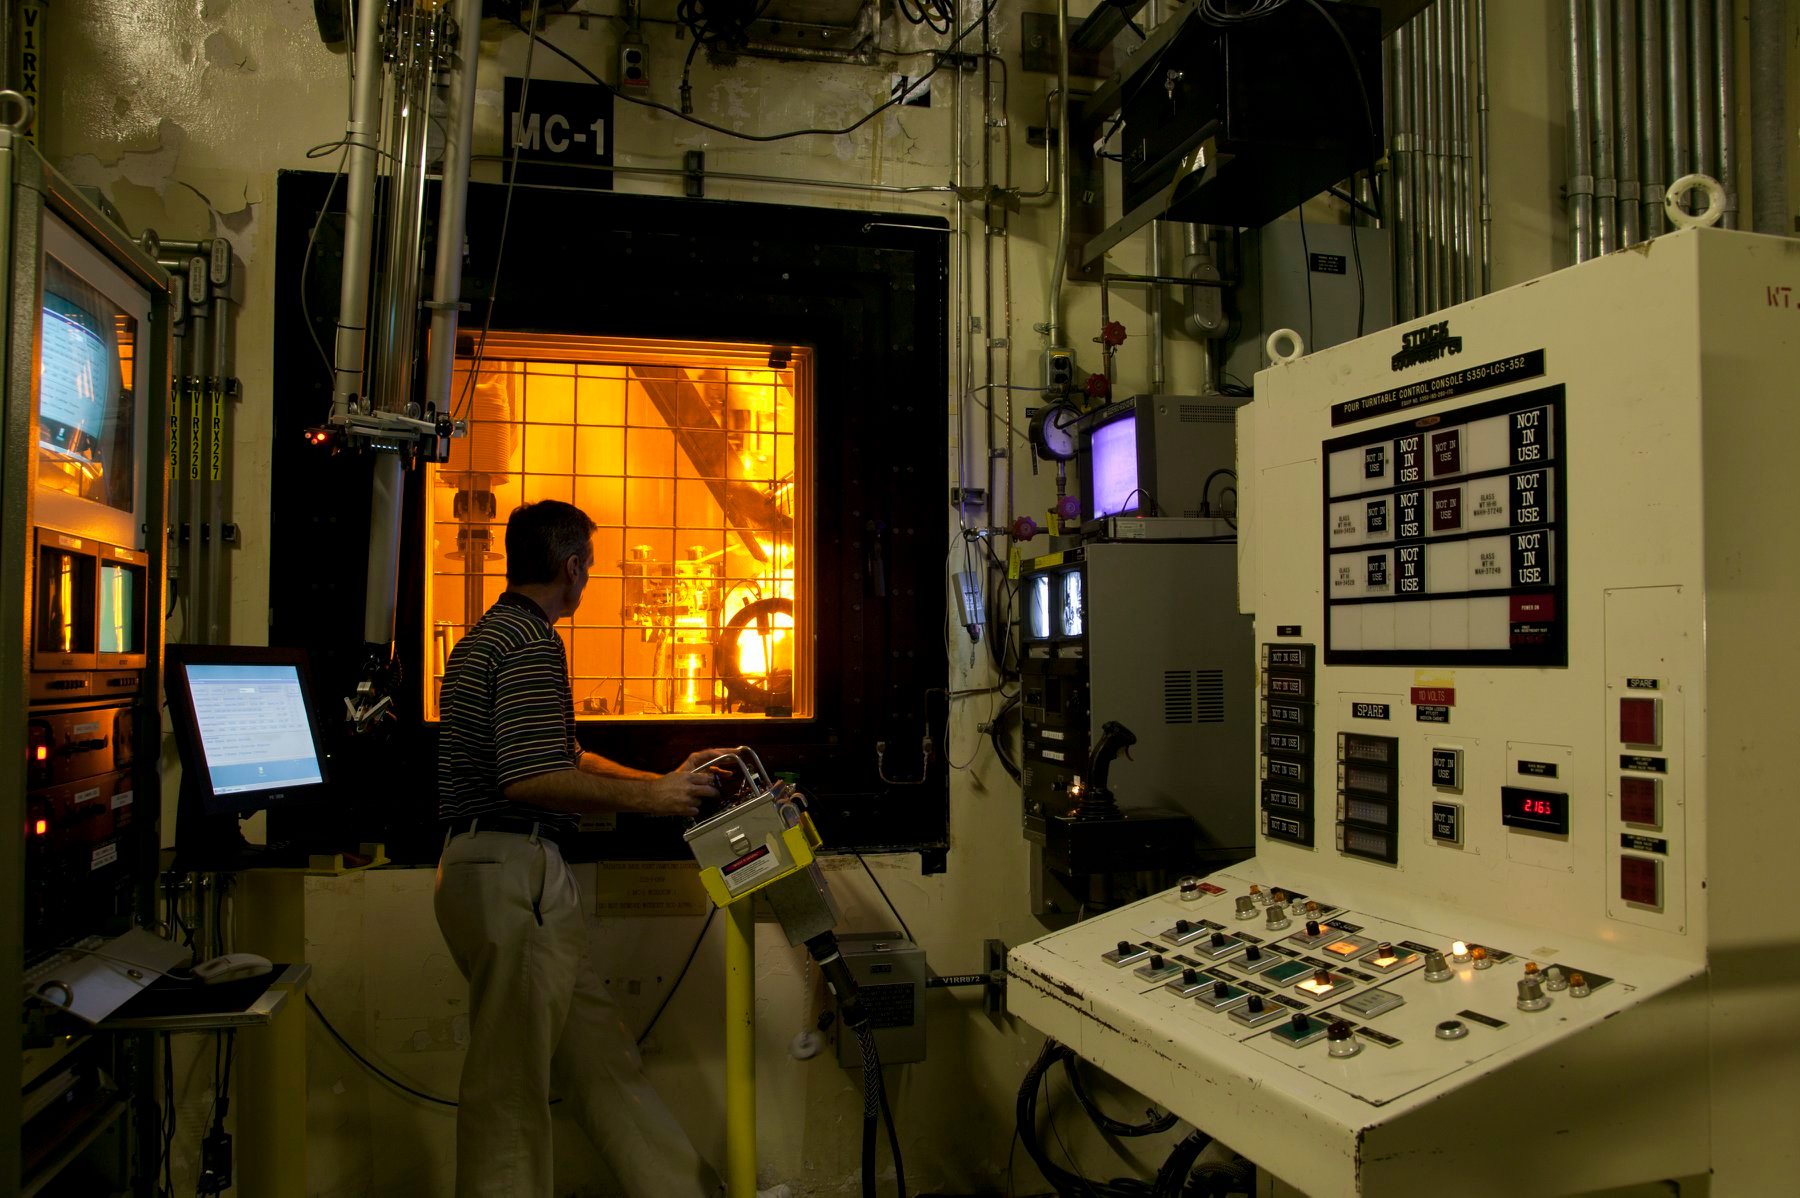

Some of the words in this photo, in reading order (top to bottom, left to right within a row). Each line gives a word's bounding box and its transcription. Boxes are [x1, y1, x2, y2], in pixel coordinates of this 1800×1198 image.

[511, 111, 605, 156] MC-1
[1402, 320, 1450, 350] STOCK
[1344, 398, 1360, 413] POUR
[1361, 393, 1397, 409] TURNTABLE
[1400, 384, 1429, 399] CONTROL
[1431, 375, 1464, 390] CONSOLE
[1516, 411, 1540, 429] NOT
[1522, 429, 1535, 444] IN
[1400, 437, 1418, 453] NOT
[1435, 442, 1447, 452] NOT
[1449, 440, 1456, 449] IN
[1366, 453, 1376, 463] NOT
[1377, 452, 1384, 461] IN
[1440, 452, 1452, 462] USE
[1517, 445, 1540, 461] USE
[1404, 453, 1414, 467] IN
[1369, 463, 1380, 473] USE
[1400, 468, 1418, 482] USE
[1516, 473, 1539, 490] NOT
[1400, 493, 1419, 507] NOT
[1481, 493, 1495, 501] GLASS
[1522, 491, 1534, 506] IN
[1435, 500, 1448, 509] NOT
[1449, 498, 1457, 508] IN
[1368, 508, 1378, 517] NOT
[1379, 506, 1386, 514] IN
[1404, 508, 1414, 521] IN
[1440, 510, 1452, 520] USE
[1517, 507, 1540, 523] USE
[1371, 517, 1383, 526] USE
[1401, 523, 1419, 536] USE
[1518, 534, 1540, 550] NOT
[1400, 548, 1419, 562] NOT
[1481, 552, 1495, 560] GLASS
[1523, 551, 1536, 566] IN
[1368, 563, 1379, 571] NOT
[1380, 562, 1386, 570] IN
[1404, 563, 1414, 576] IN
[1371, 572, 1383, 581] USE
[1519, 568, 1541, 583] USE
[1401, 578, 1419, 591] USE
[1272, 653, 1282, 662] NOT
[1283, 653, 1289, 661] IN
[1289, 653, 1299, 661] USE
[1272, 681, 1282, 690] NOT
[1282, 682, 1289, 691] IN
[1289, 682, 1299, 691] USE
[1631, 679, 1654, 688] SPARE
[1427, 691, 1445, 702] VOLTS
[1272, 708, 1282, 717] NOT
[1282, 710, 1288, 719] IN
[1288, 711, 1298, 720] USE
[1357, 704, 1384, 718] SPARE
[1270, 736, 1280, 746] NOT
[1281, 737, 1287, 746] IN
[1288, 738, 1297, 747] USE
[1434, 758, 1446, 768] NOT
[1447, 759, 1454, 768] IN
[1271, 764, 1280, 773] NOT
[1281, 765, 1287, 774] IN
[1288, 767, 1298, 776] USE
[1437, 769, 1450, 779] USE
[1270, 793, 1280, 803] NOT
[1281, 794, 1287, 803] IN
[1288, 796, 1297, 805] USE
[1434, 813, 1447, 824] NOT
[1447, 814, 1454, 824] IN
[1271, 820, 1280, 830] NOT
[1281, 822, 1287, 831] IN
[1288, 824, 1297, 833] USE
[1438, 824, 1451, 834] USE
